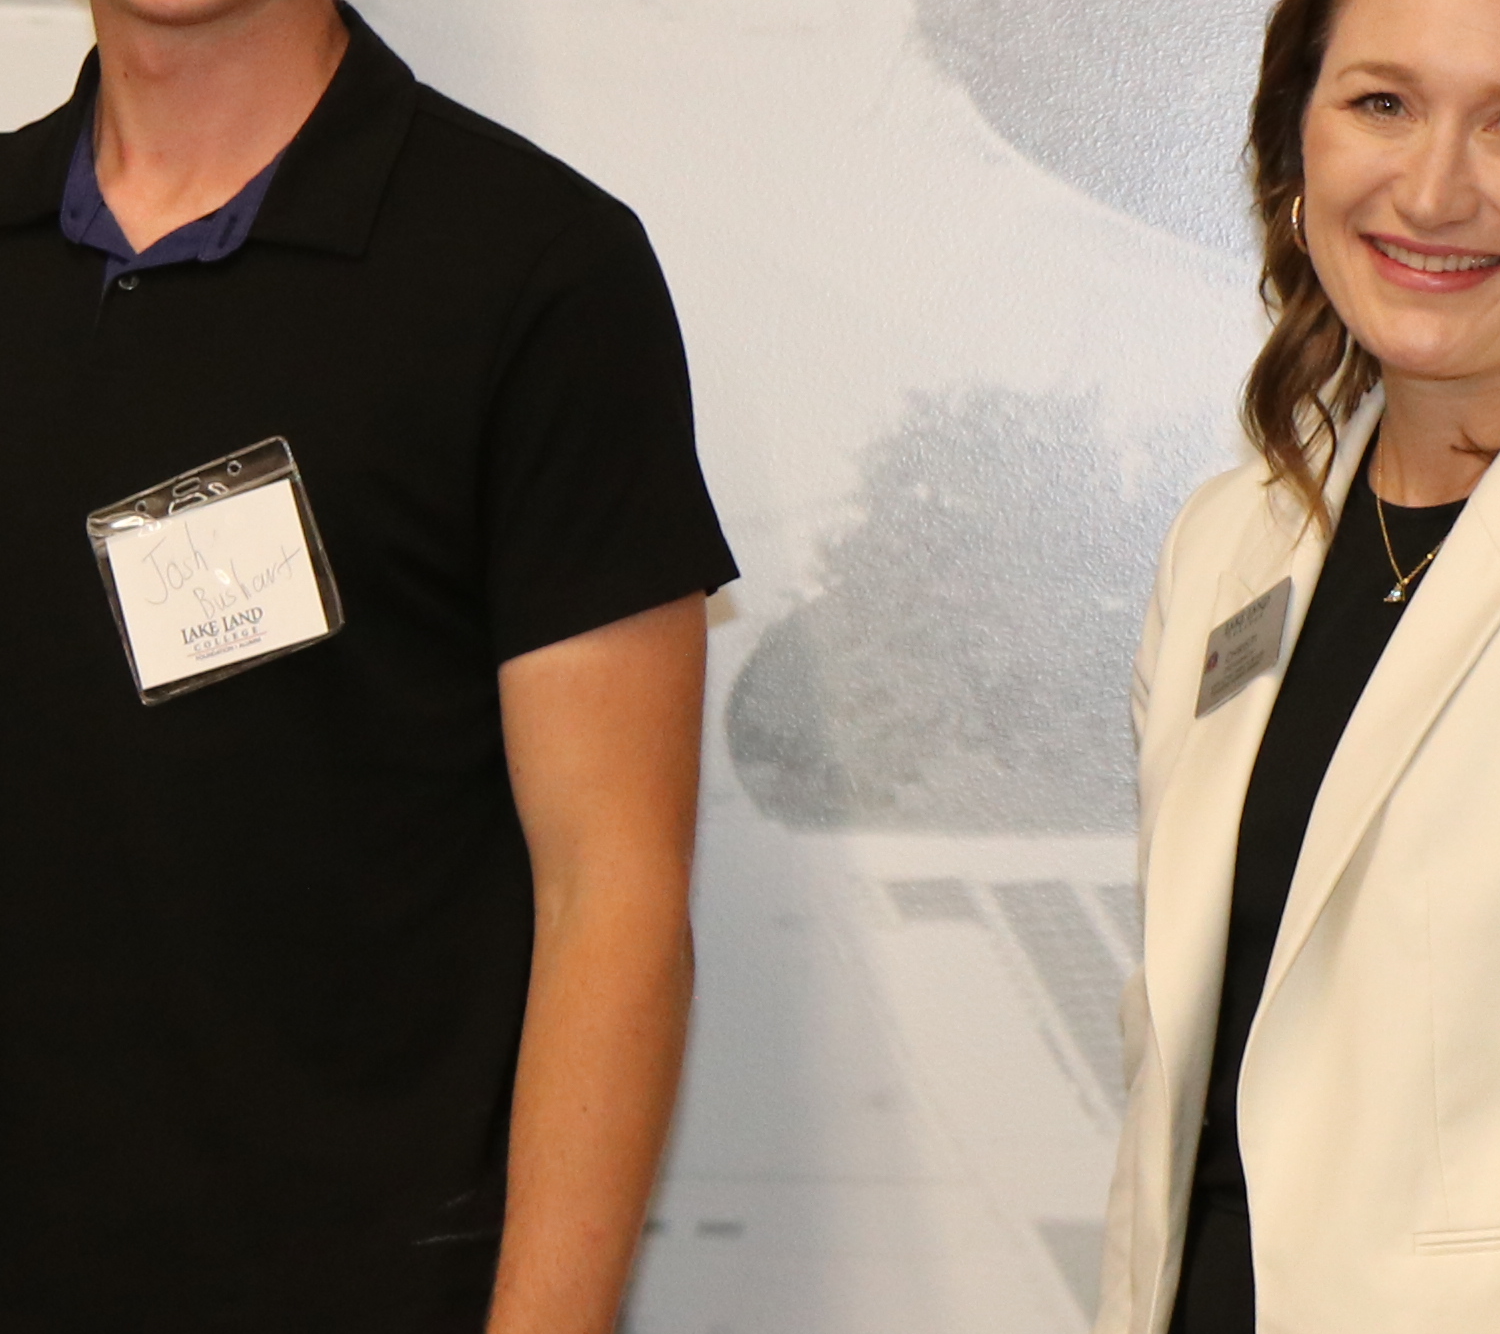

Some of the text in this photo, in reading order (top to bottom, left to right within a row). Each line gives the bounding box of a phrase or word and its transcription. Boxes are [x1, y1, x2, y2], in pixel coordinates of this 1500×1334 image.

[180, 605, 265, 646] LAKE LAND
[193, 626, 259, 652] COLLEGE
